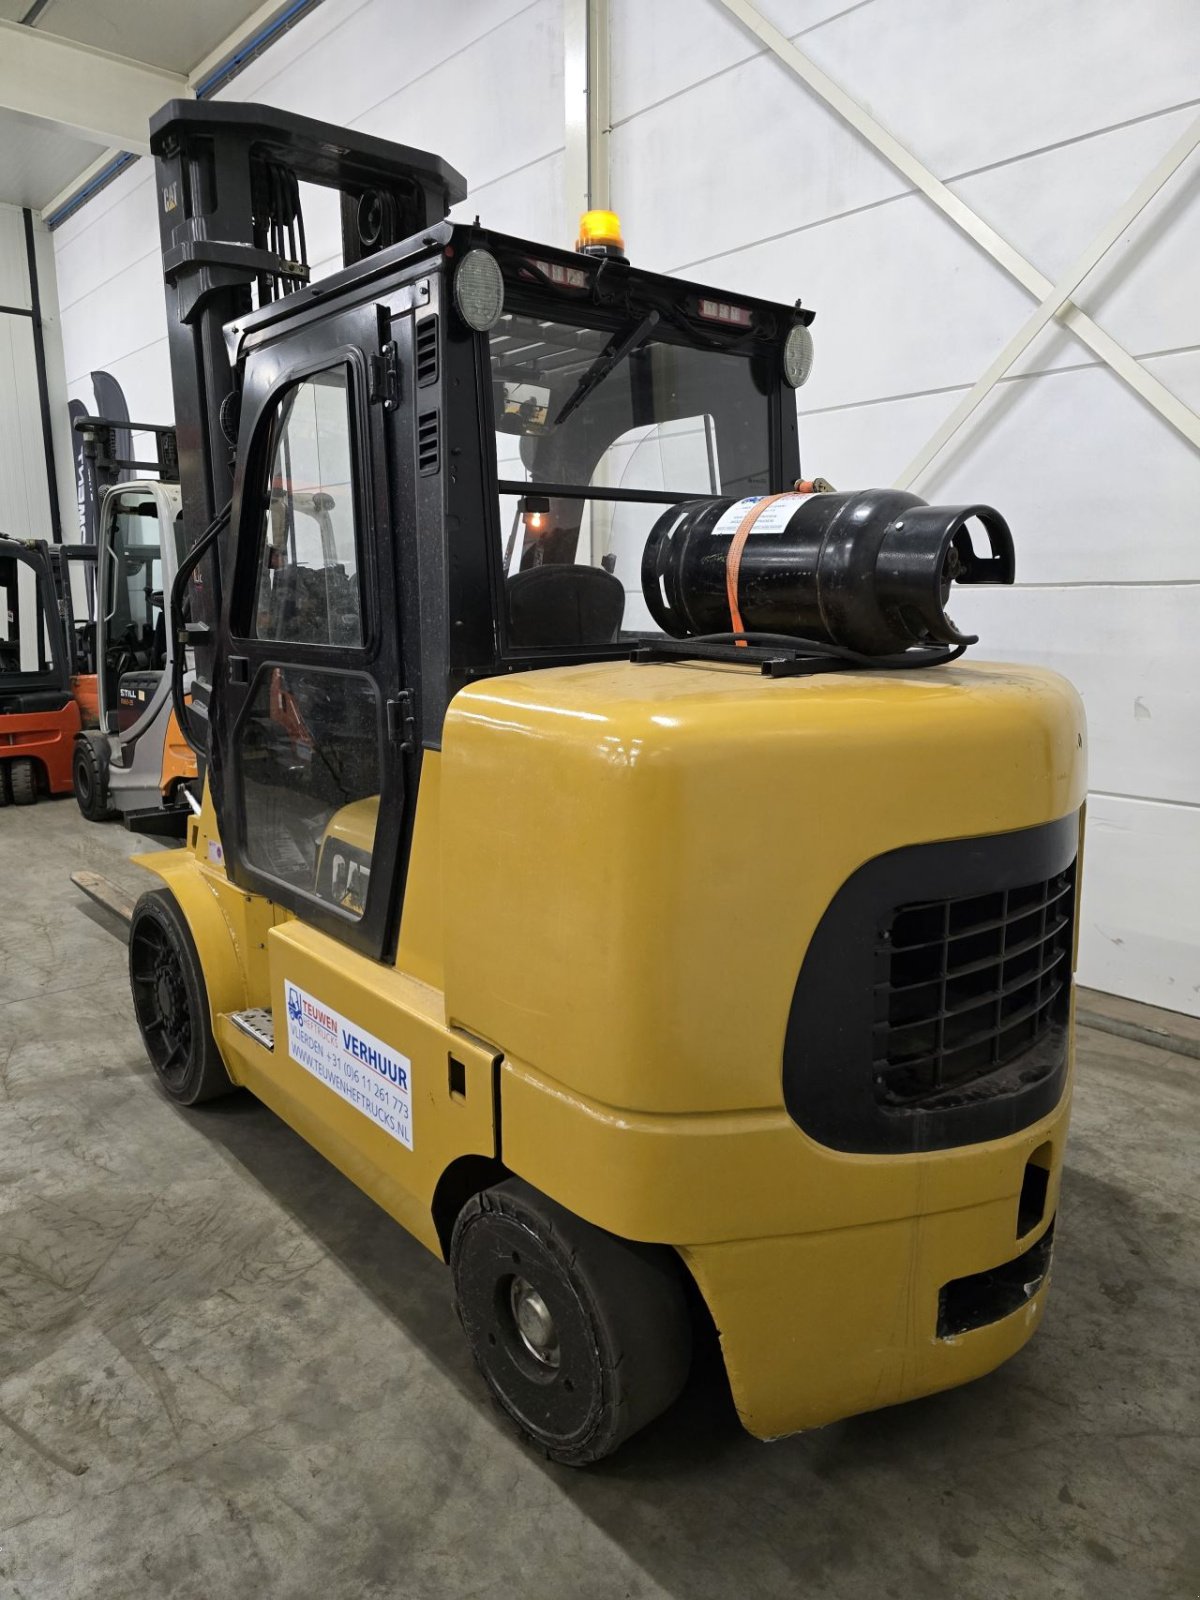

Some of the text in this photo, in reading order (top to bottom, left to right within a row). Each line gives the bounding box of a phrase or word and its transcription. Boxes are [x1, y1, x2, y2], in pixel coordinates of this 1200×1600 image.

[163, 181, 177, 213] CAT
[120, 688, 137, 699] STILL
[303, 999, 338, 1034] TEUWEN
[304, 1018, 339, 1048] HEFTRUCKS
[291, 1023, 409, 1119] VLIERDEN +31 (0)6 11 261 773
[342, 1029, 408, 1091] VERHUUR
[291, 1039, 410, 1143] WWW.TEUWENHEFTRUCKS.NL
